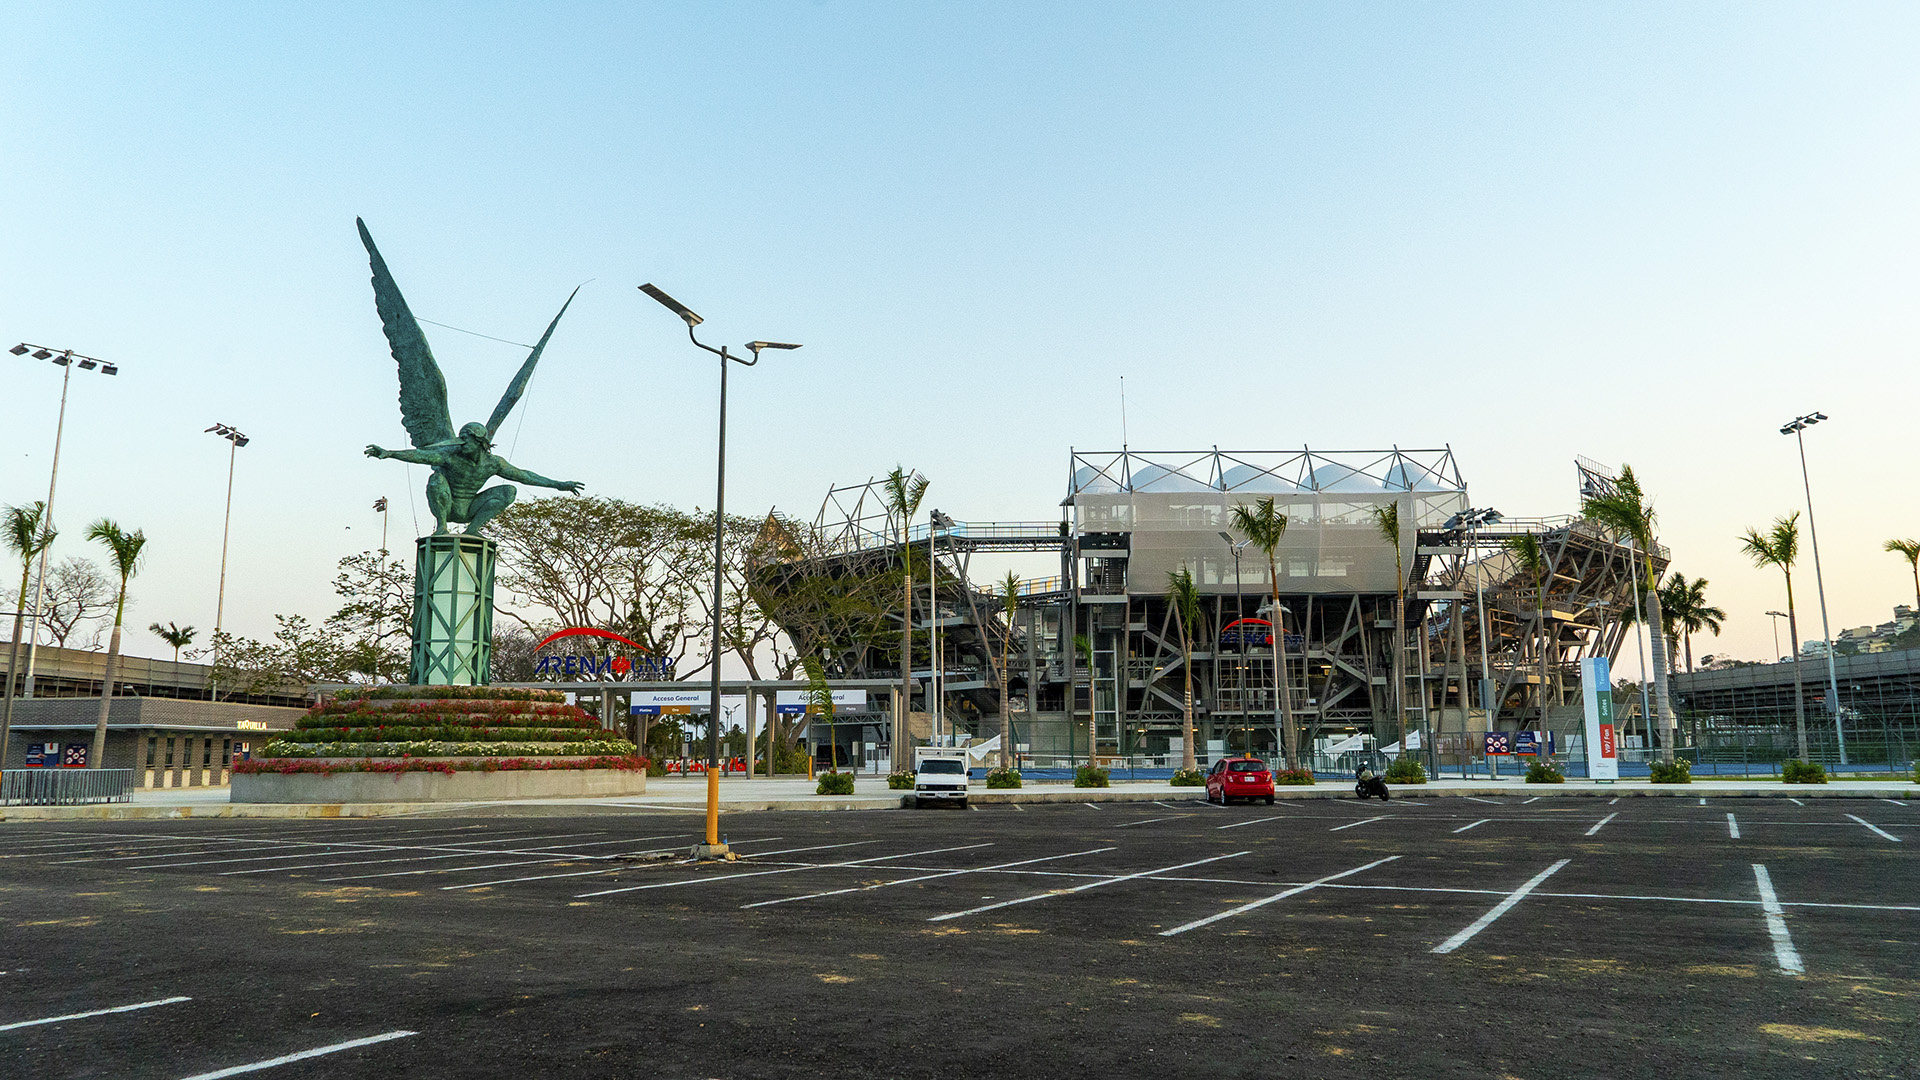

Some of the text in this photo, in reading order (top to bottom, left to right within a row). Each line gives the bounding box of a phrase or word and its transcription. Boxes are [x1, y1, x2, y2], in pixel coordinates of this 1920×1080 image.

[1221, 633, 1266, 644] ARNA
[534, 656, 673, 674] ARENA GNP
[237, 720, 267, 730] TAQUILLA
[684, 733, 692, 742] B
